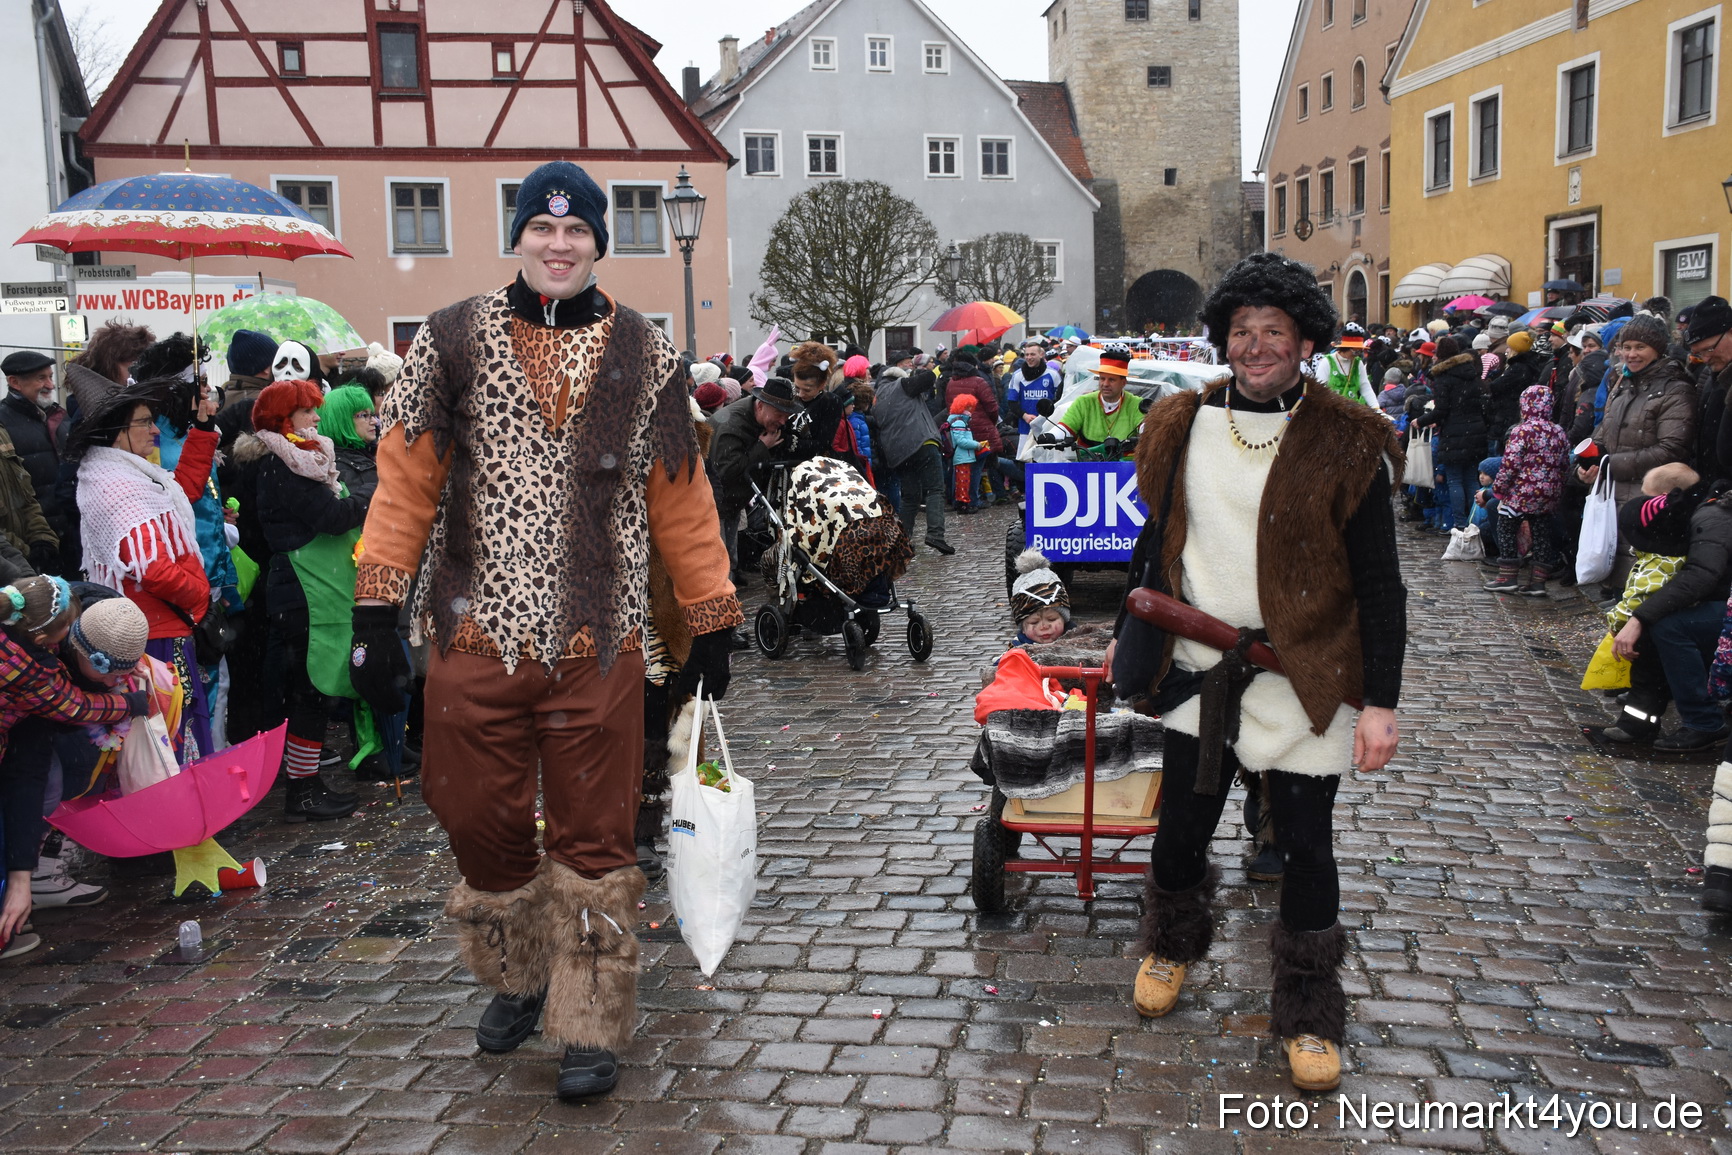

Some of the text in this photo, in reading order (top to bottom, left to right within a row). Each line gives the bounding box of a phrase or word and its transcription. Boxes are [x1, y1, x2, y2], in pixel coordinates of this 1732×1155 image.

[1679, 252, 1705, 269] BW
[79, 268, 131, 278] Probststraße
[1677, 270, 1706, 280] Bekleidung
[6, 285, 63, 296] Forstergasse
[1033, 472, 1147, 528] DJK
[672, 819, 696, 832] HUBER
